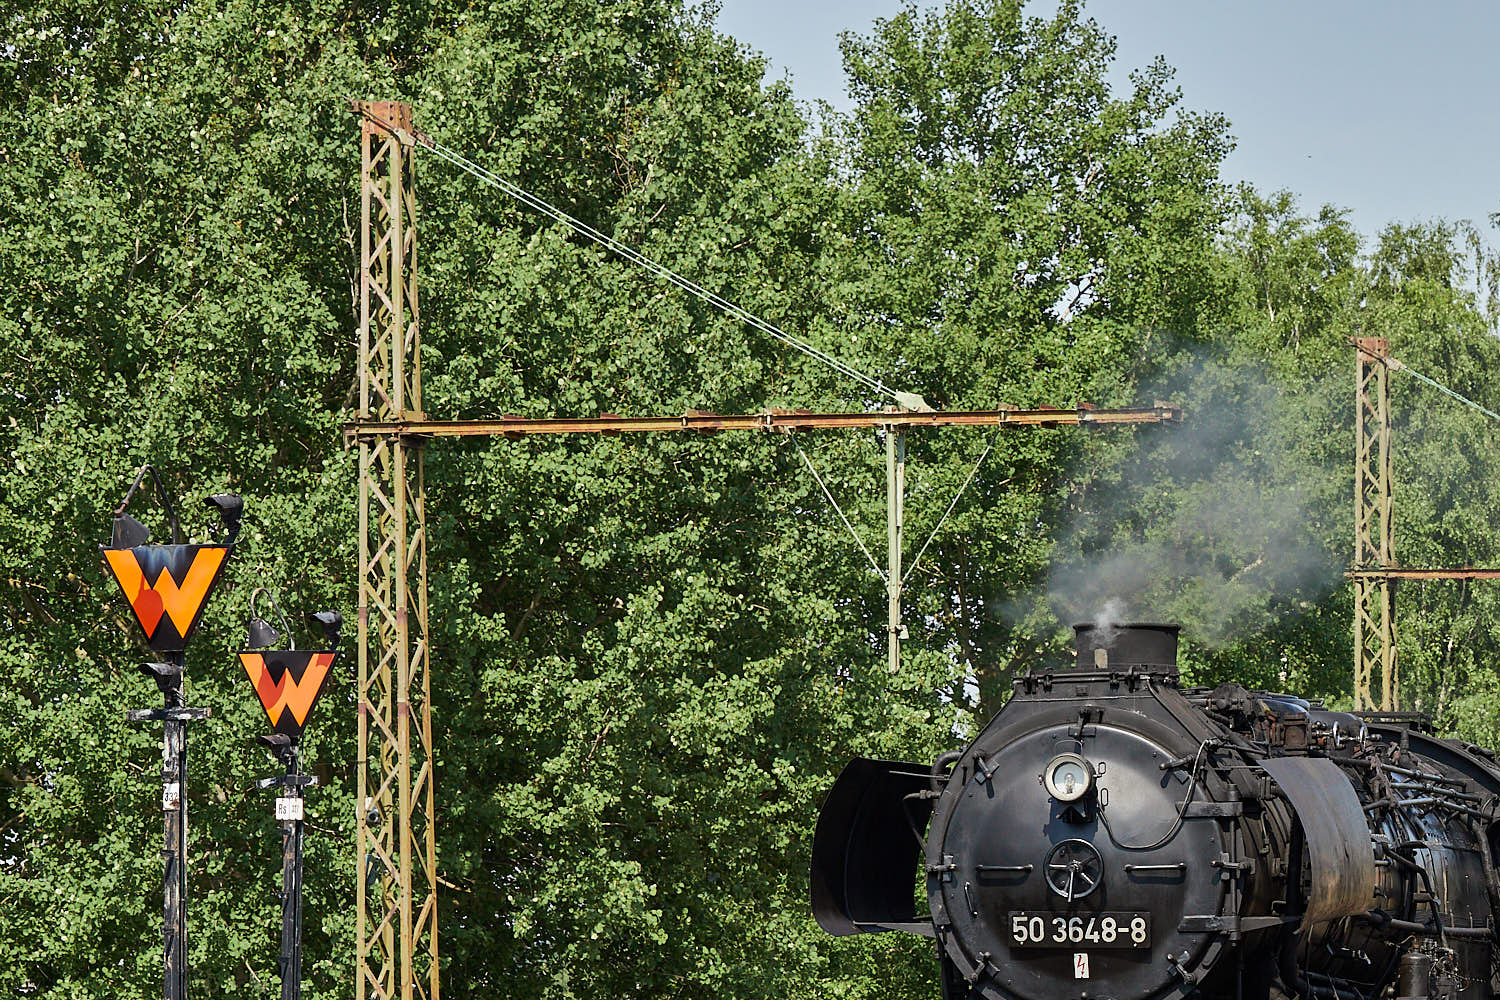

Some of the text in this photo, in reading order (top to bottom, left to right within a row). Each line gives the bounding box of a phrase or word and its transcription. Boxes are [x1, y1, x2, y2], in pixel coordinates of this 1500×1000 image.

[104, 548, 228, 639] W
[238, 653, 336, 728] W
[278, 803, 287, 815] Rs
[1012, 916, 1147, 943] 50 3648-8
